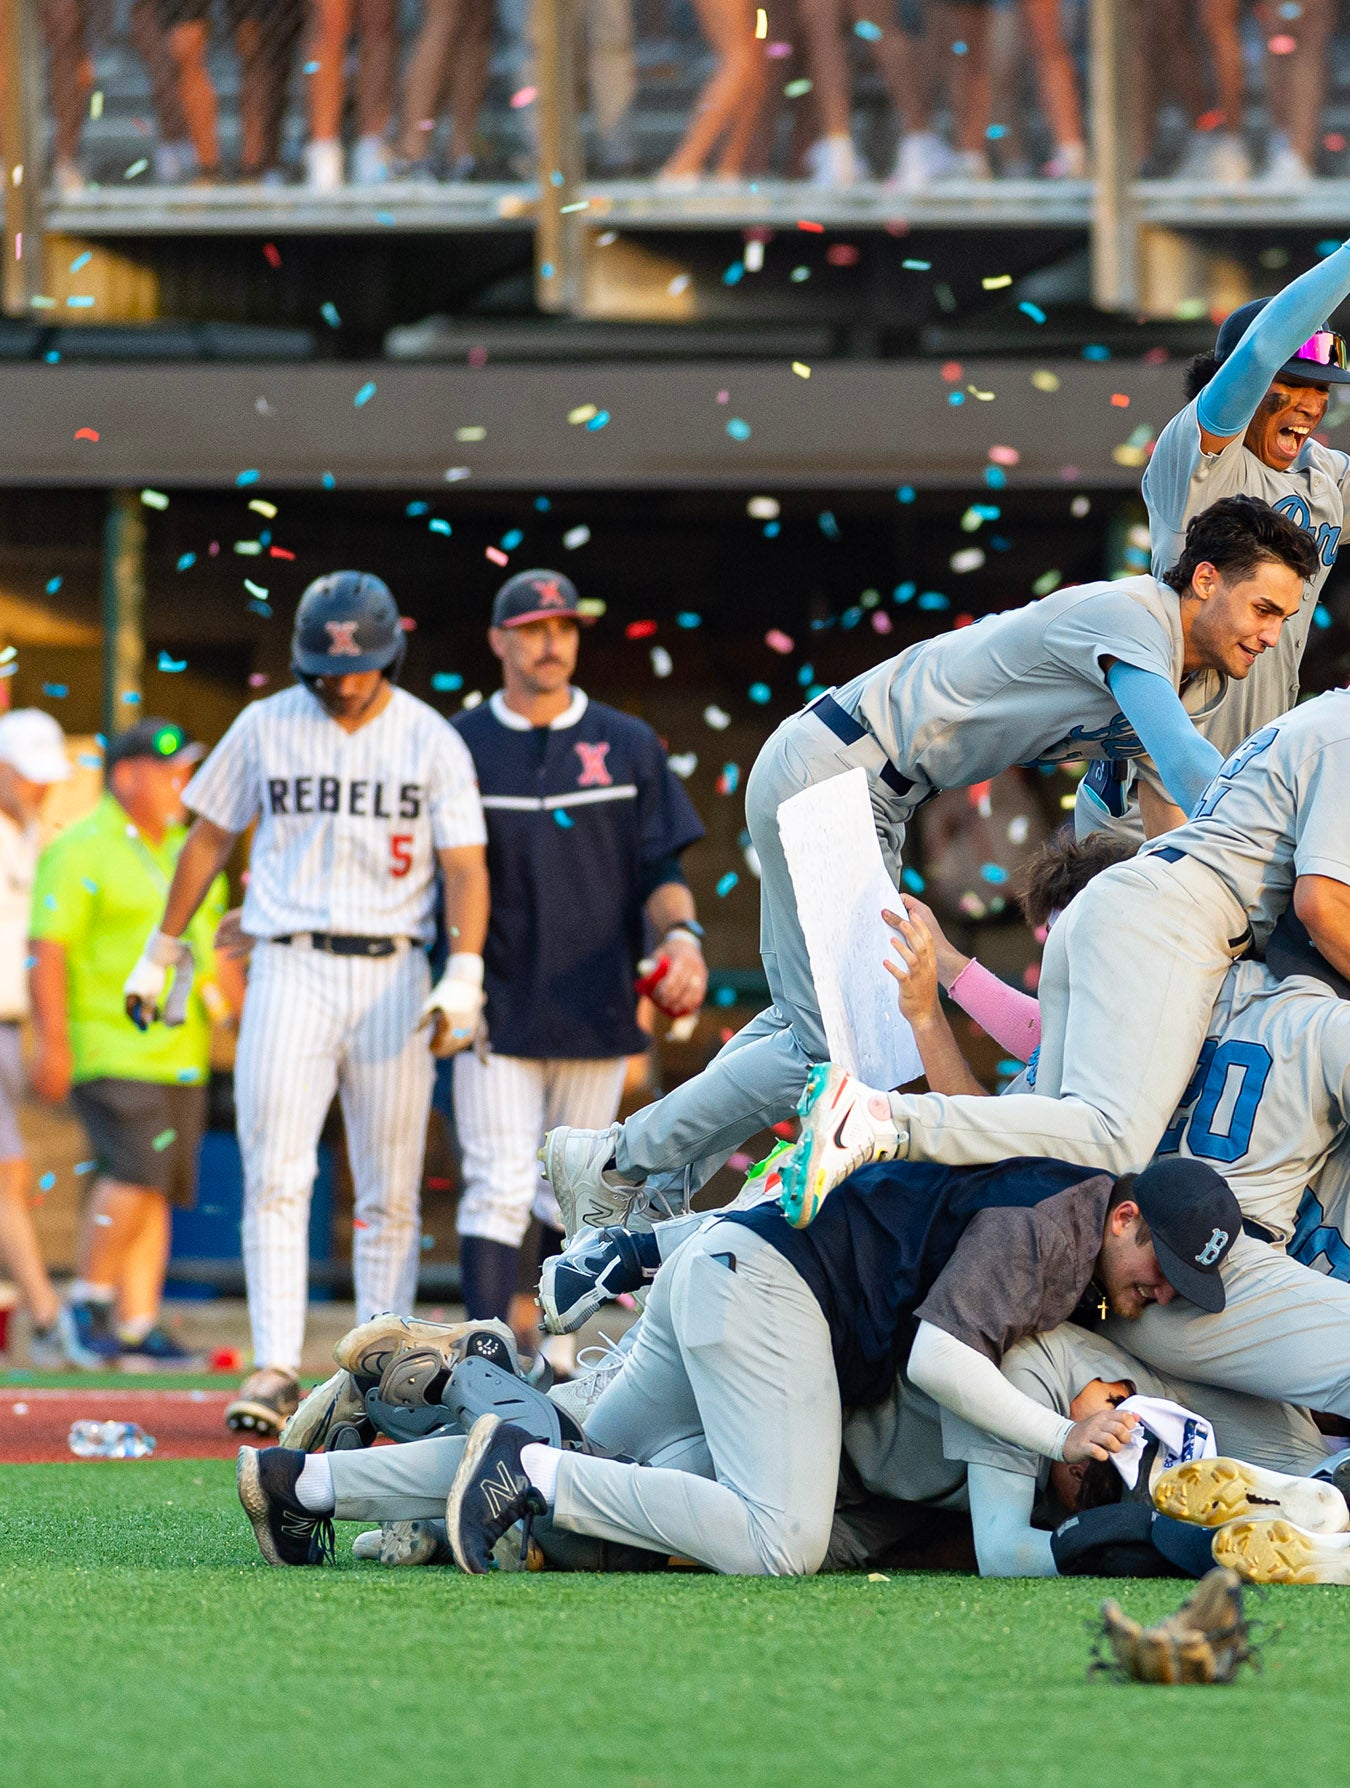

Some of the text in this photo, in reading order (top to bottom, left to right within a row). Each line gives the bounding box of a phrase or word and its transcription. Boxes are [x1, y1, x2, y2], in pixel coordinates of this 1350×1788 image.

[268, 776, 421, 820] REBELS
[389, 833, 415, 879] 5
[1194, 1227, 1230, 1267] B
